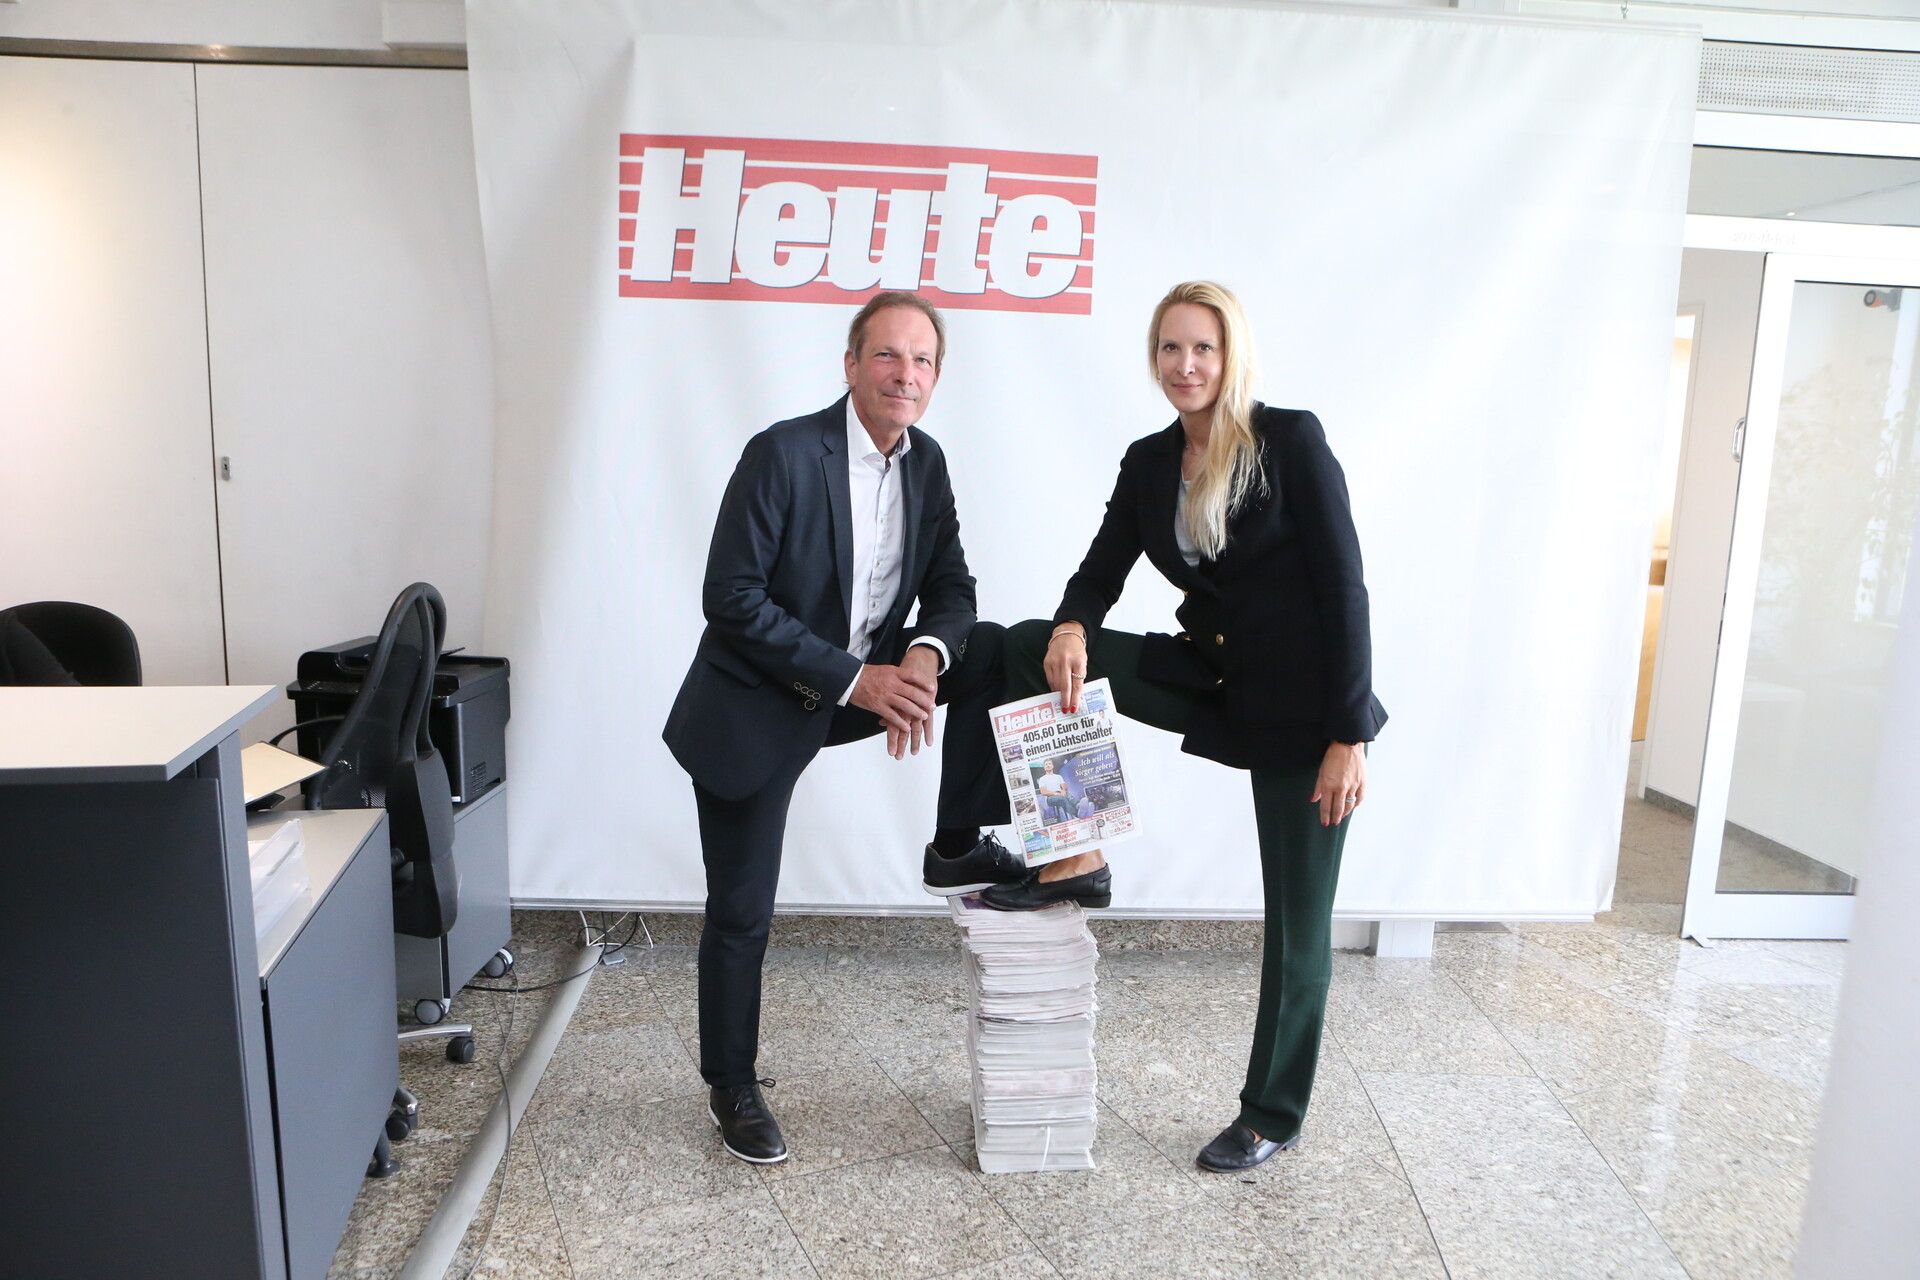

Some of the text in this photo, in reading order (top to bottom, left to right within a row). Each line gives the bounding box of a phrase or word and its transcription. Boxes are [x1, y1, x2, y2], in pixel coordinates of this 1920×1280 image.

[630, 146, 1084, 300] Heute
[998, 706, 1055, 733] Heute
[1023, 726, 1055, 744] 405,60
[1057, 722, 1079, 735] Euro
[1081, 717, 1095, 728] für
[1026, 744, 1054, 757] einen
[1053, 727, 1113, 749] Lichtschalter
